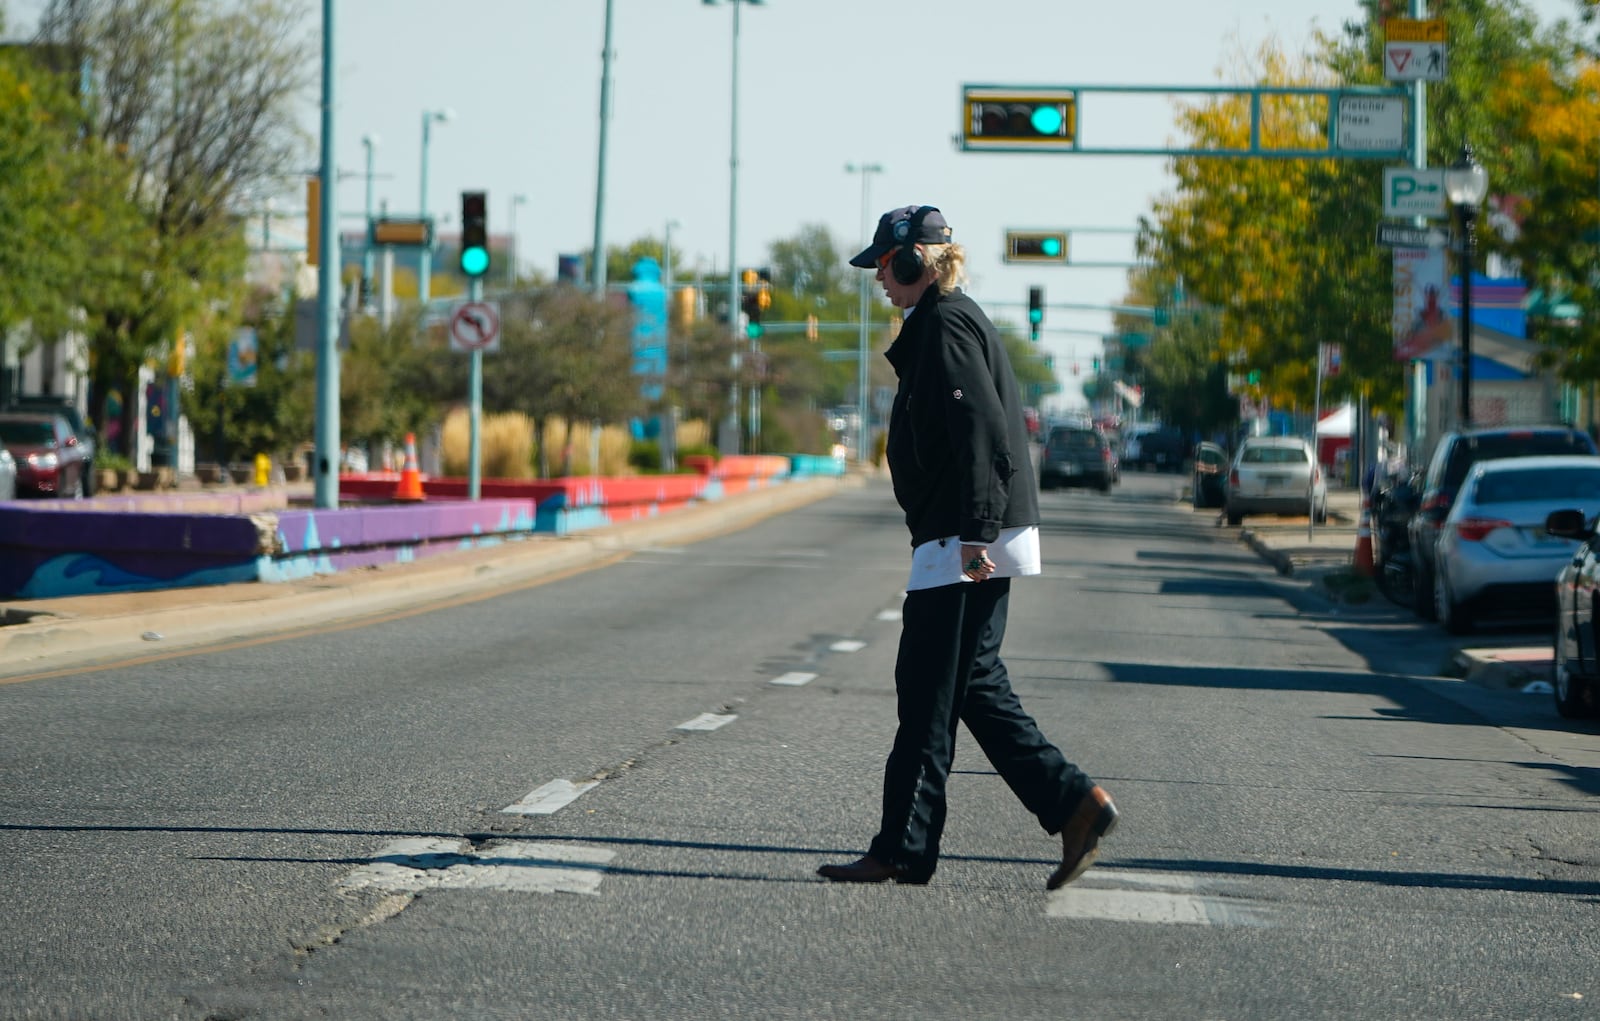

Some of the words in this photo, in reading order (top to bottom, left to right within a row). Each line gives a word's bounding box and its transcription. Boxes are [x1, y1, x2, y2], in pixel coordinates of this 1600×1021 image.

[1341, 101, 1385, 111] Fletcher
[1341, 114, 1370, 125] Plaza
[1392, 176, 1416, 208] P
